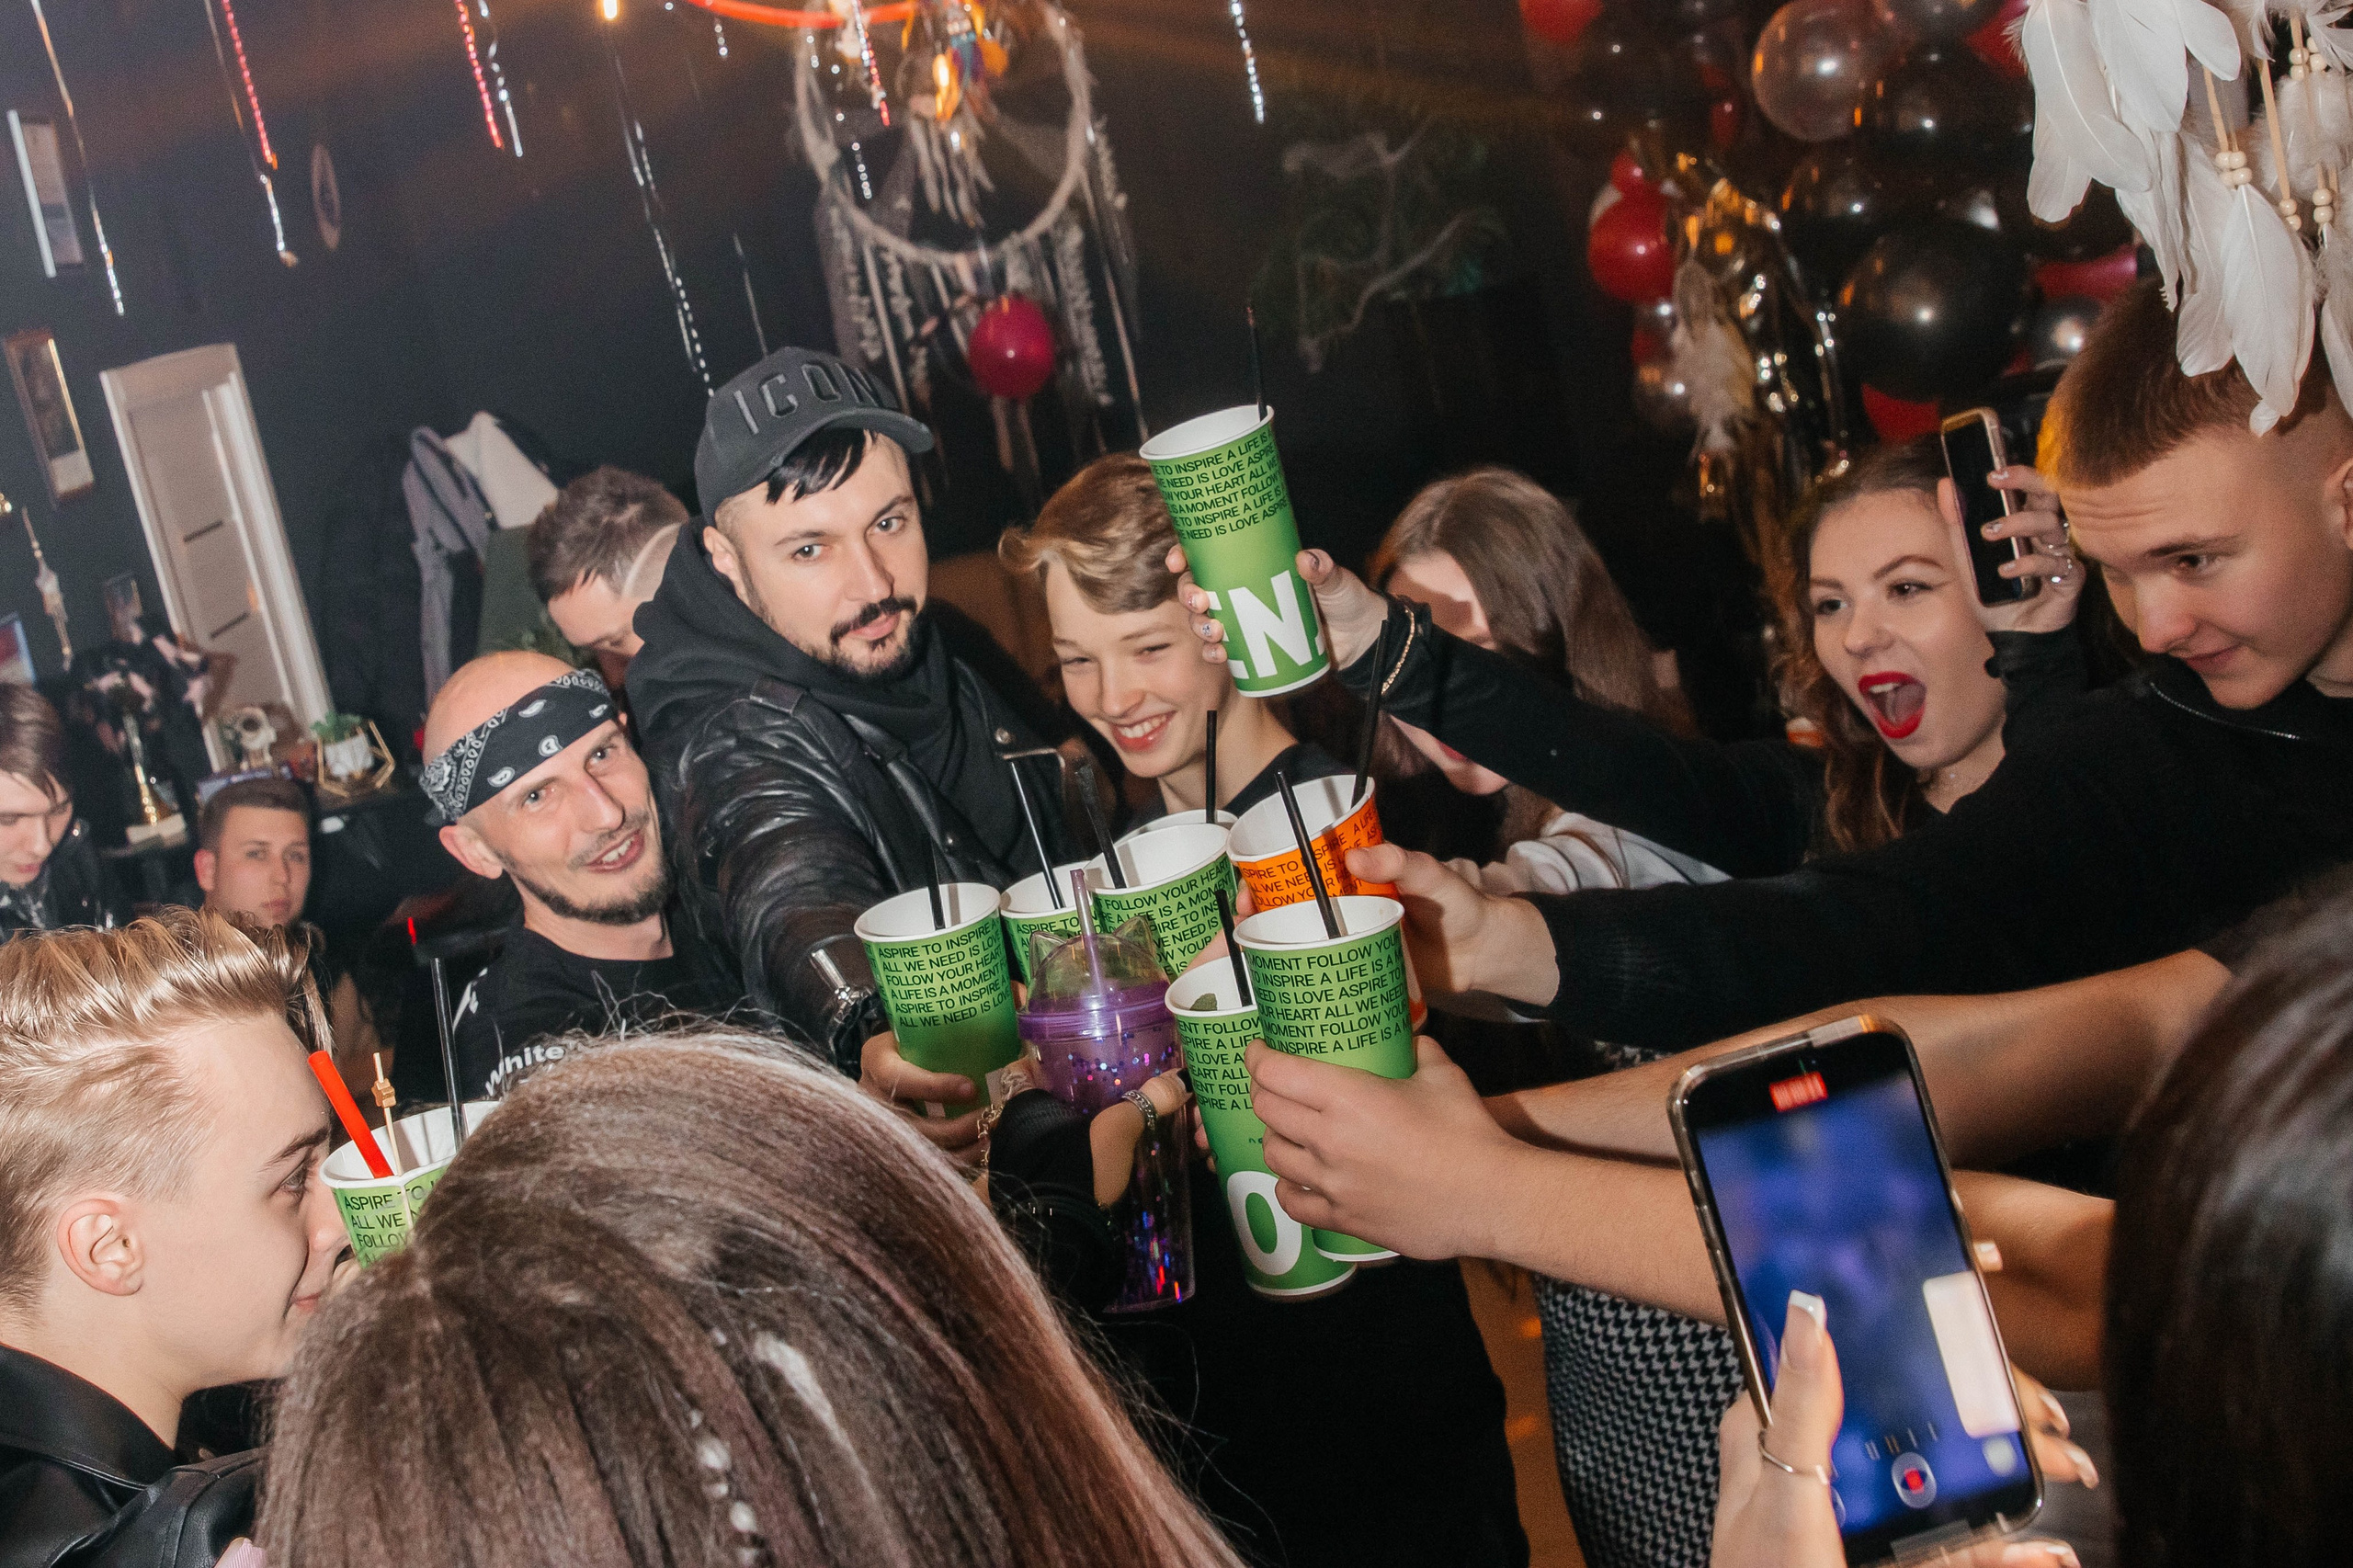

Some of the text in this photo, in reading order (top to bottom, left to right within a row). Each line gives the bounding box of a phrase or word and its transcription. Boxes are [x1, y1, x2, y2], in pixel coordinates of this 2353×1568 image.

[733, 361, 883, 435] ICON
[1160, 465, 1173, 475] TO
[1175, 453, 1224, 474] INSPIRE
[1227, 449, 1236, 460] A
[1238, 437, 1259, 456] LIFE
[1260, 431, 1268, 444] IS
[1166, 476, 1194, 488] NEED
[1197, 472, 1210, 483] IS
[1212, 460, 1245, 480] LOVE
[1247, 442, 1275, 467] ASPIRE
[1173, 488, 1204, 501] YOUR
[1205, 473, 1245, 496] HEART
[1249, 465, 1267, 482] ALL
[1267, 456, 1279, 471] WE
[1178, 504, 1186, 514] A
[1185, 491, 1238, 514] MOMENT
[1241, 473, 1279, 499] FOLLOW
[1180, 517, 1193, 527] TO
[1194, 506, 1240, 526] INSPIRE
[1244, 502, 1252, 514] A
[1253, 490, 1275, 508] LIFE
[1274, 485, 1282, 496] IS
[1187, 528, 1212, 540] NEED
[1215, 524, 1227, 536] IS
[1229, 513, 1260, 532] LOVE
[1242, 867, 1277, 881] SPIRE
[1277, 860, 1299, 873] TO
[1301, 832, 1347, 867] ISPIRE
[1354, 823, 1361, 835] A
[1105, 893, 1157, 911] FOLLOW
[1161, 879, 1199, 901] YOUR
[1200, 858, 1229, 885] HEART
[1257, 878, 1336, 907] OLLOW YOR
[1261, 881, 1285, 893] WE
[1286, 867, 1321, 889] NEE
[1324, 858, 1336, 872] IS
[1060, 916, 1079, 930] TO
[1151, 911, 1199, 933] PIRE TO
[1159, 905, 1175, 918] IS
[1176, 901, 1190, 913] A
[879, 946, 920, 959] ASPIRE
[922, 943, 942, 955] TO
[946, 922, 991, 950] INSPIRE
[1172, 924, 1206, 945] NEED
[1207, 916, 1219, 930] IS
[882, 929, 1000, 971] ALL WE NEED IS LOVE
[885, 972, 933, 986] FOLLOW
[937, 962, 974, 982] YOUR
[975, 944, 1002, 970] HEART
[1307, 943, 1372, 969] FOLLOW
[1375, 930, 1400, 953] YOUR
[892, 988, 898, 1000] A
[899, 988, 923, 1000] LIFE
[925, 987, 938, 998] IS
[939, 984, 949, 996] A
[950, 962, 999, 994] MOMENT
[1262, 973, 1315, 987] INSPIRE
[1320, 971, 1332, 985] A
[1336, 963, 1369, 983] LIFE
[1371, 959, 1383, 973] IS
[1386, 954, 1393, 968] A
[1279, 992, 1291, 1005] IS
[1294, 988, 1335, 1005] LOVE
[1338, 973, 1388, 1000] ASPIRE
[1389, 967, 1401, 983] TO
[896, 1002, 935, 1014] ASPIRE
[936, 998, 955, 1011] TO
[959, 979, 1000, 1006] INSPIRE
[1258, 982, 1404, 1021] OUR HEART ALL WE NEED
[900, 1016, 918, 1028] ALL
[920, 1015, 940, 1028] WE
[943, 1006, 977, 1025] NEED
[980, 1001, 991, 1014] IS
[1320, 1013, 1381, 1037] FOLLOW
[1384, 998, 1407, 1021] YOUR
[1216, 1038, 1227, 1050] A
[1278, 1040, 1328, 1055] INSPIRE
[1333, 1040, 1344, 1052] A
[1347, 1031, 1378, 1051] LIFE
[1381, 1027, 1392, 1041] IS
[1394, 1022, 1402, 1036] A
[1191, 1065, 1249, 1081] EART ALL
[1195, 1053, 1231, 1065] LOVE
[1218, 1083, 1250, 1096] FOLL
[1231, 1098, 1241, 1110] A
[344, 1194, 396, 1210] ASPIRE
[351, 1212, 406, 1230] ALL WE
